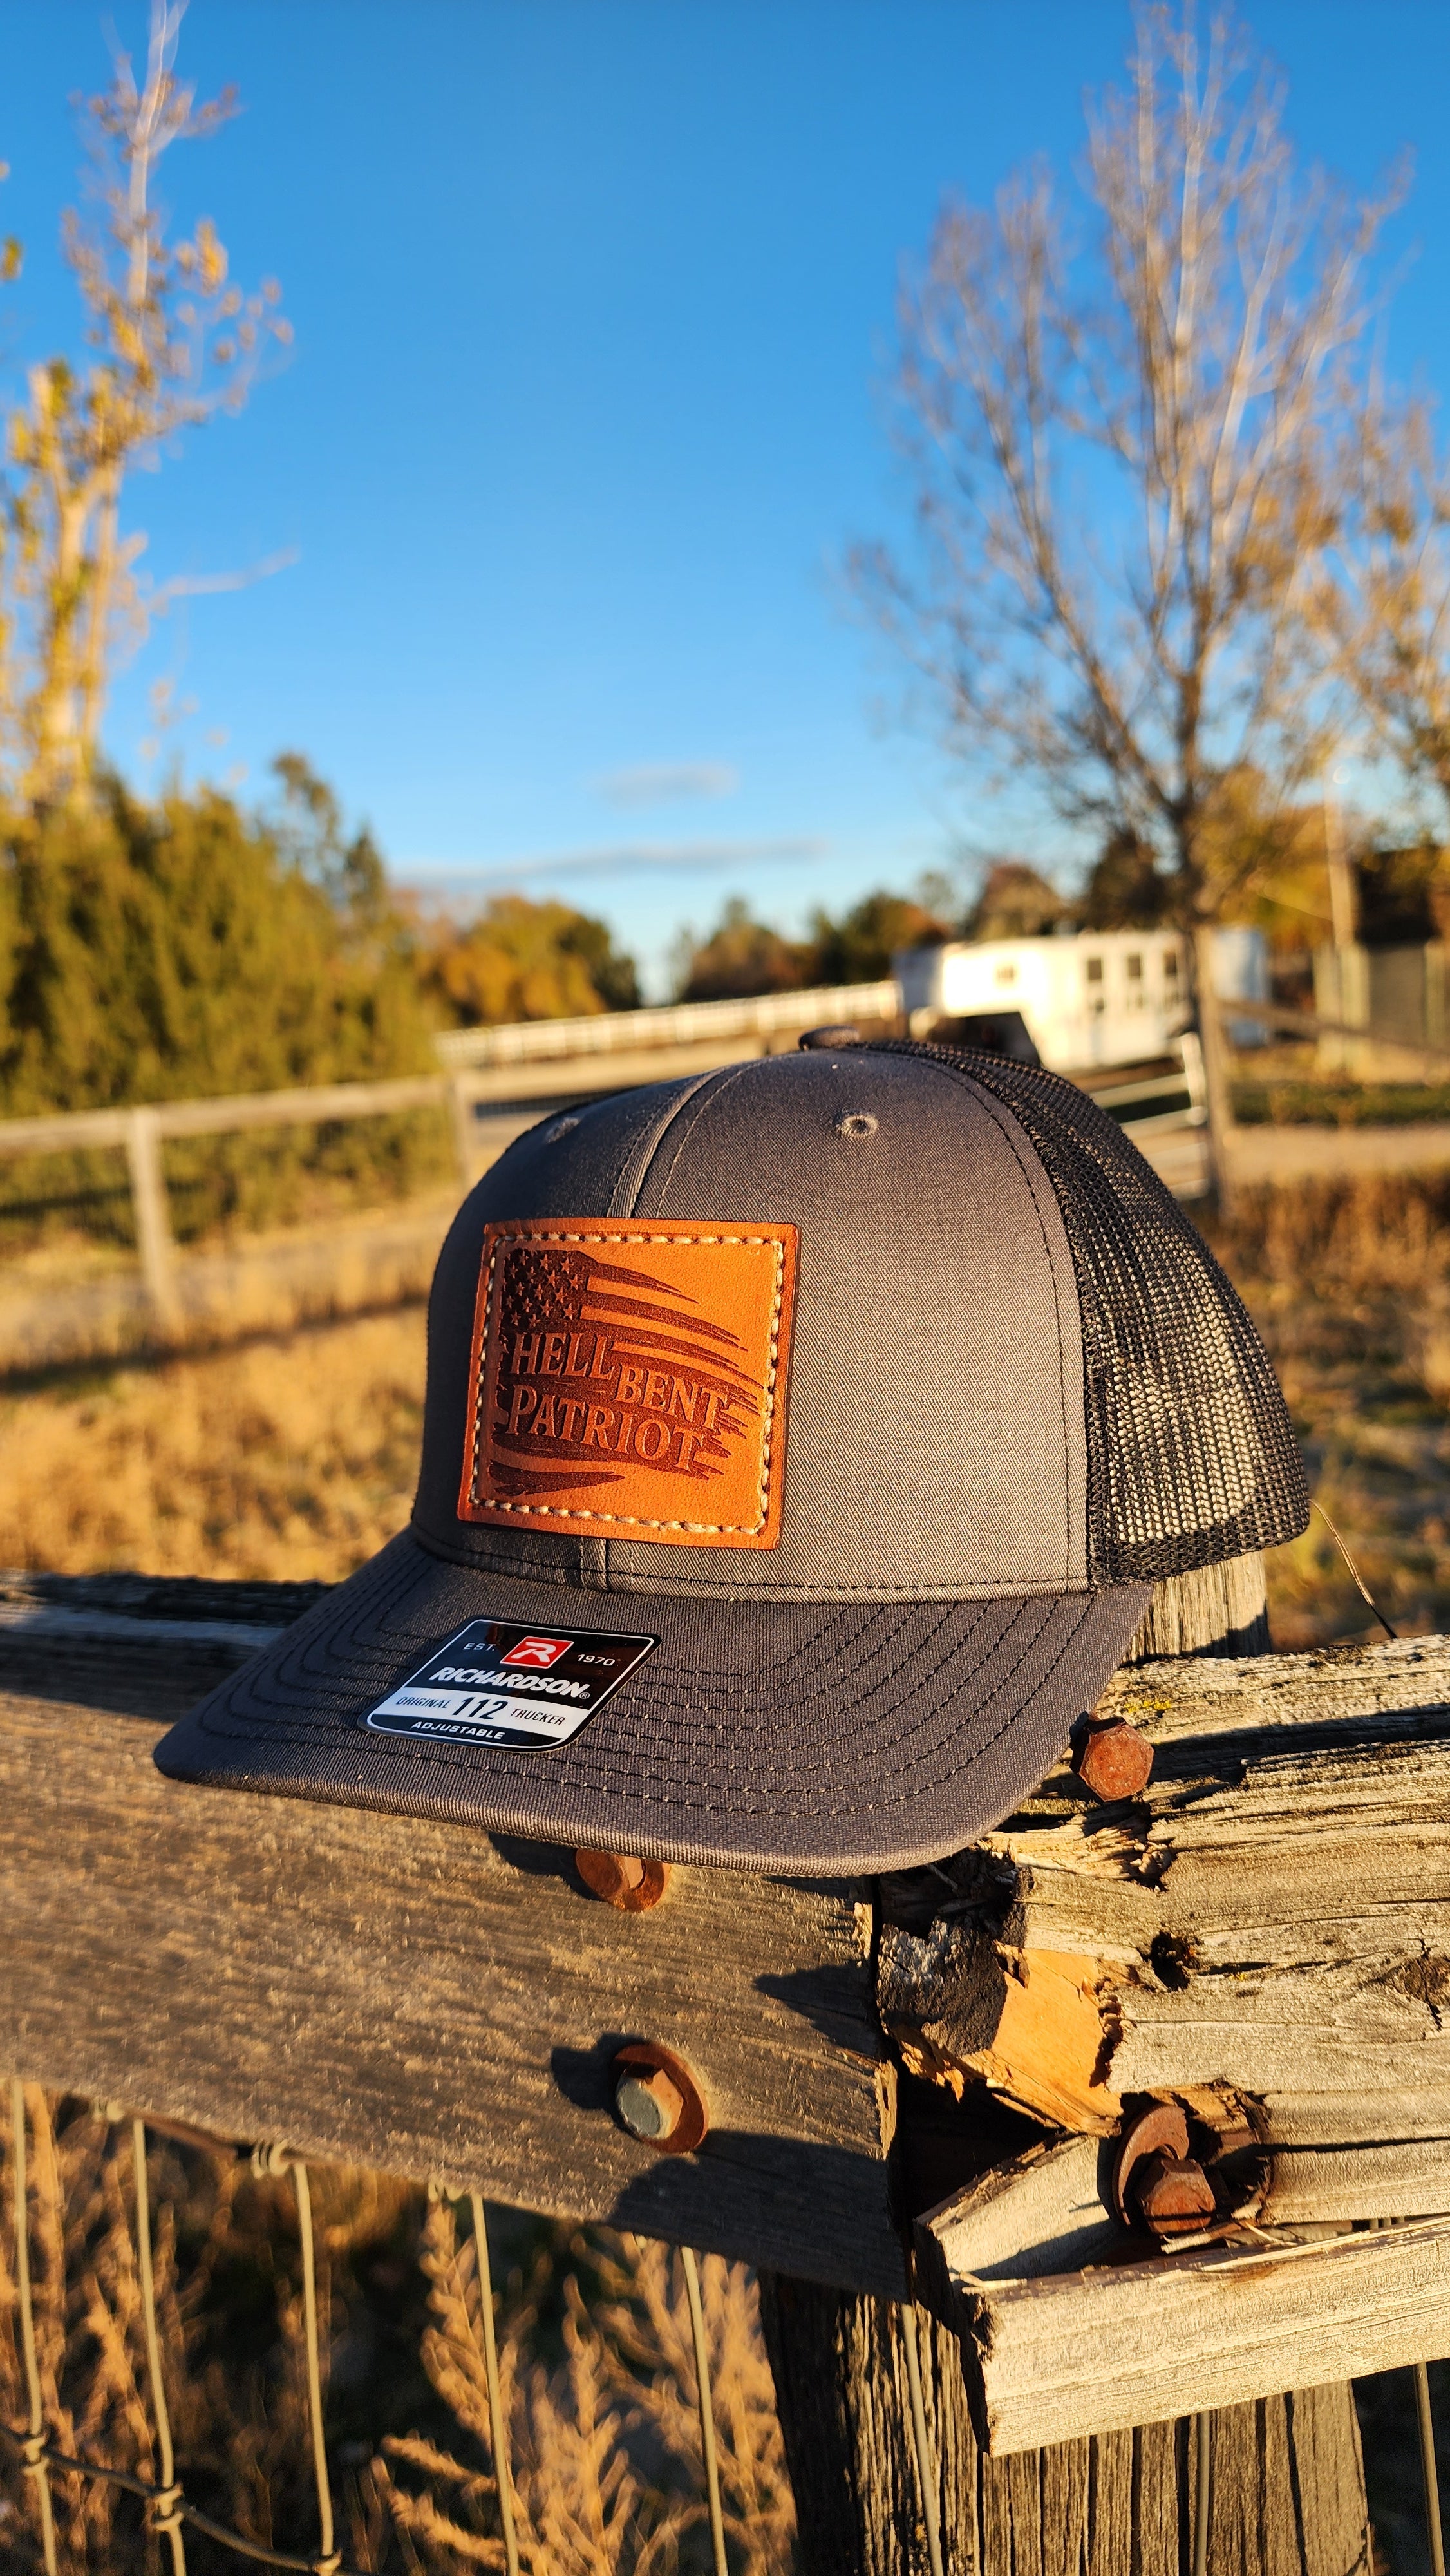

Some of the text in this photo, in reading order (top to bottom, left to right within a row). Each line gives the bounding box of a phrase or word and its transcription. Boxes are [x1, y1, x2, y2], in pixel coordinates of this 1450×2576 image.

[511, 1332, 728, 1430] HELL BENT
[506, 1385, 704, 1470] PATRIOT
[463, 1642, 495, 1652] EST.
[577, 1653, 616, 1667] 1970
[396, 1696, 565, 1726] ORIGINAL 112 TRUCKER
[411, 1721, 505, 1739] ADJUSTABLE
